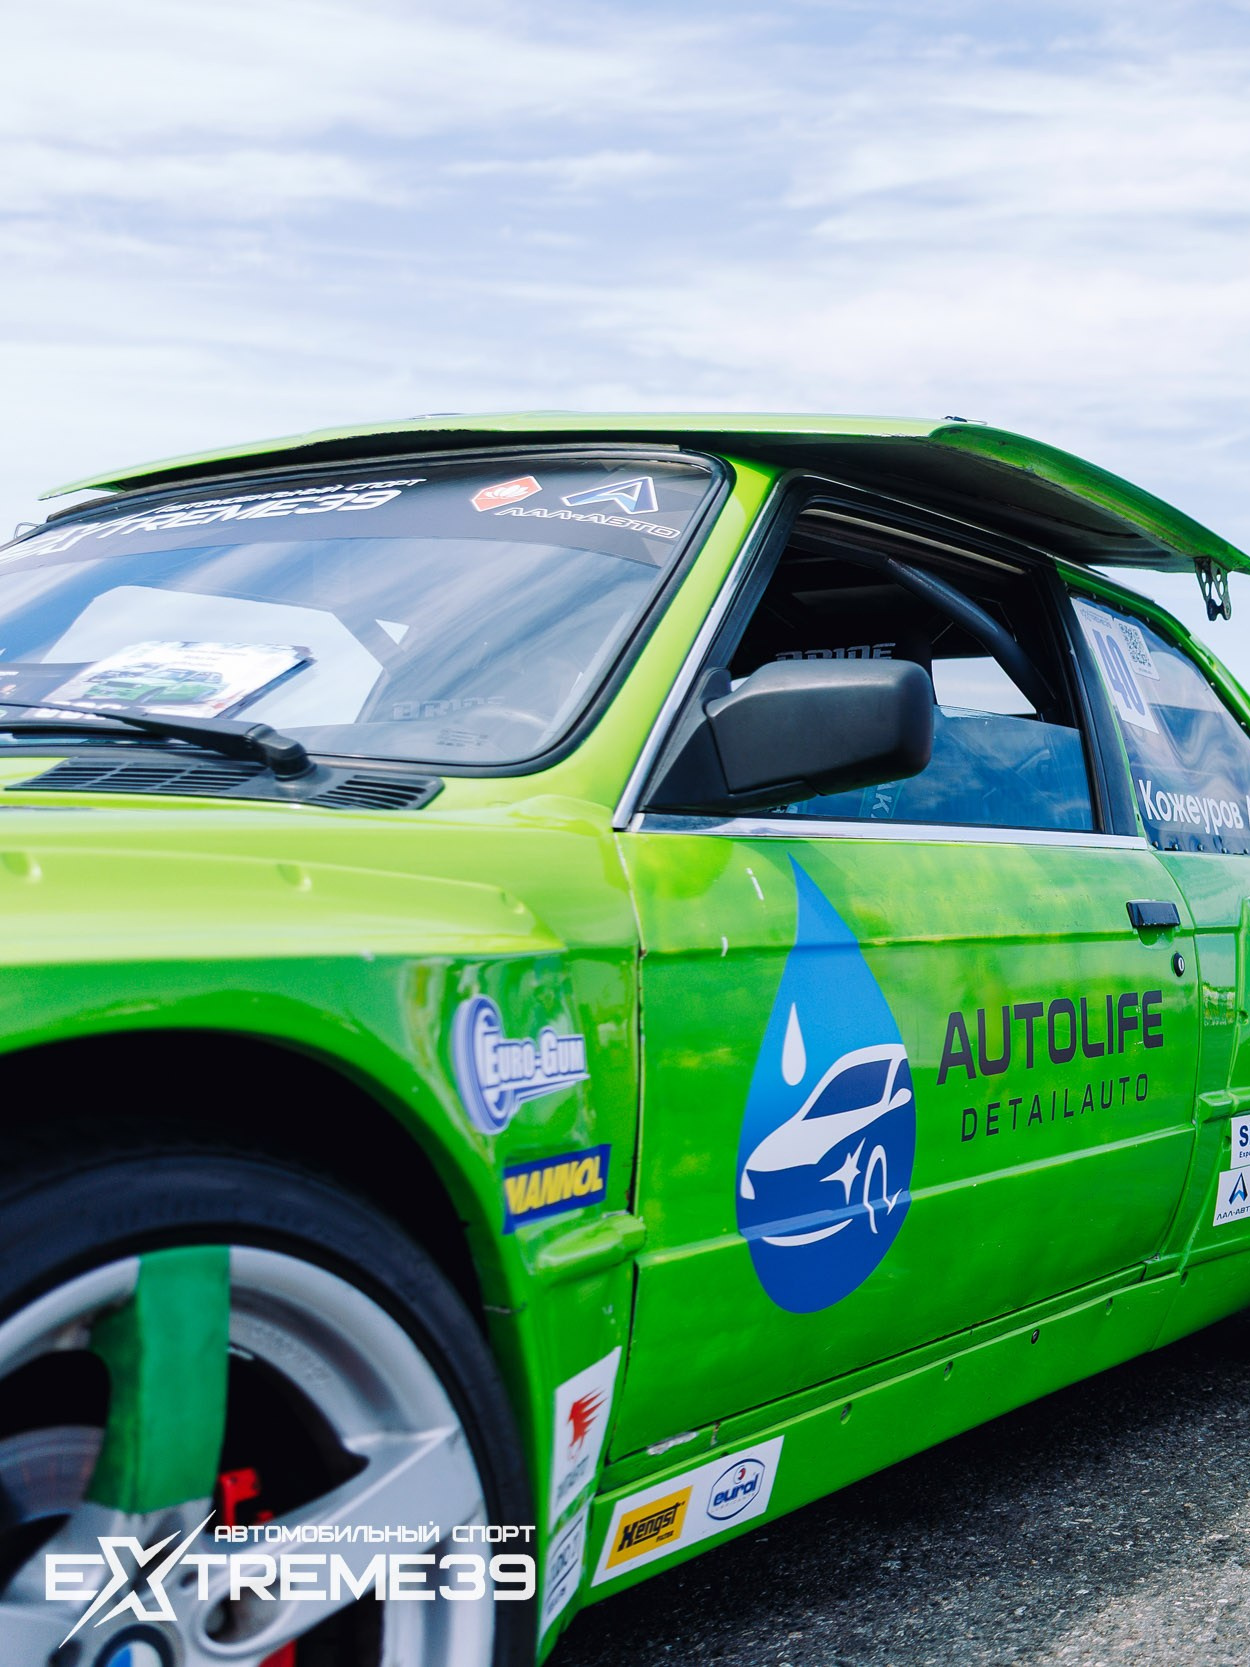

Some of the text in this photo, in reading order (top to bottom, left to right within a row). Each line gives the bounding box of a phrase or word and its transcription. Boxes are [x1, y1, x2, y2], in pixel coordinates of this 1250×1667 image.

[1092, 628, 1145, 716] 40
[1139, 779, 1244, 835] Кожеуров
[936, 989, 1164, 1086] AUTOLIFE
[961, 1073, 1148, 1143] DETAILAUTO
[505, 1155, 604, 1215] MANNOL
[713, 1472, 759, 1507] eurol
[617, 1501, 681, 1552] Hengst
